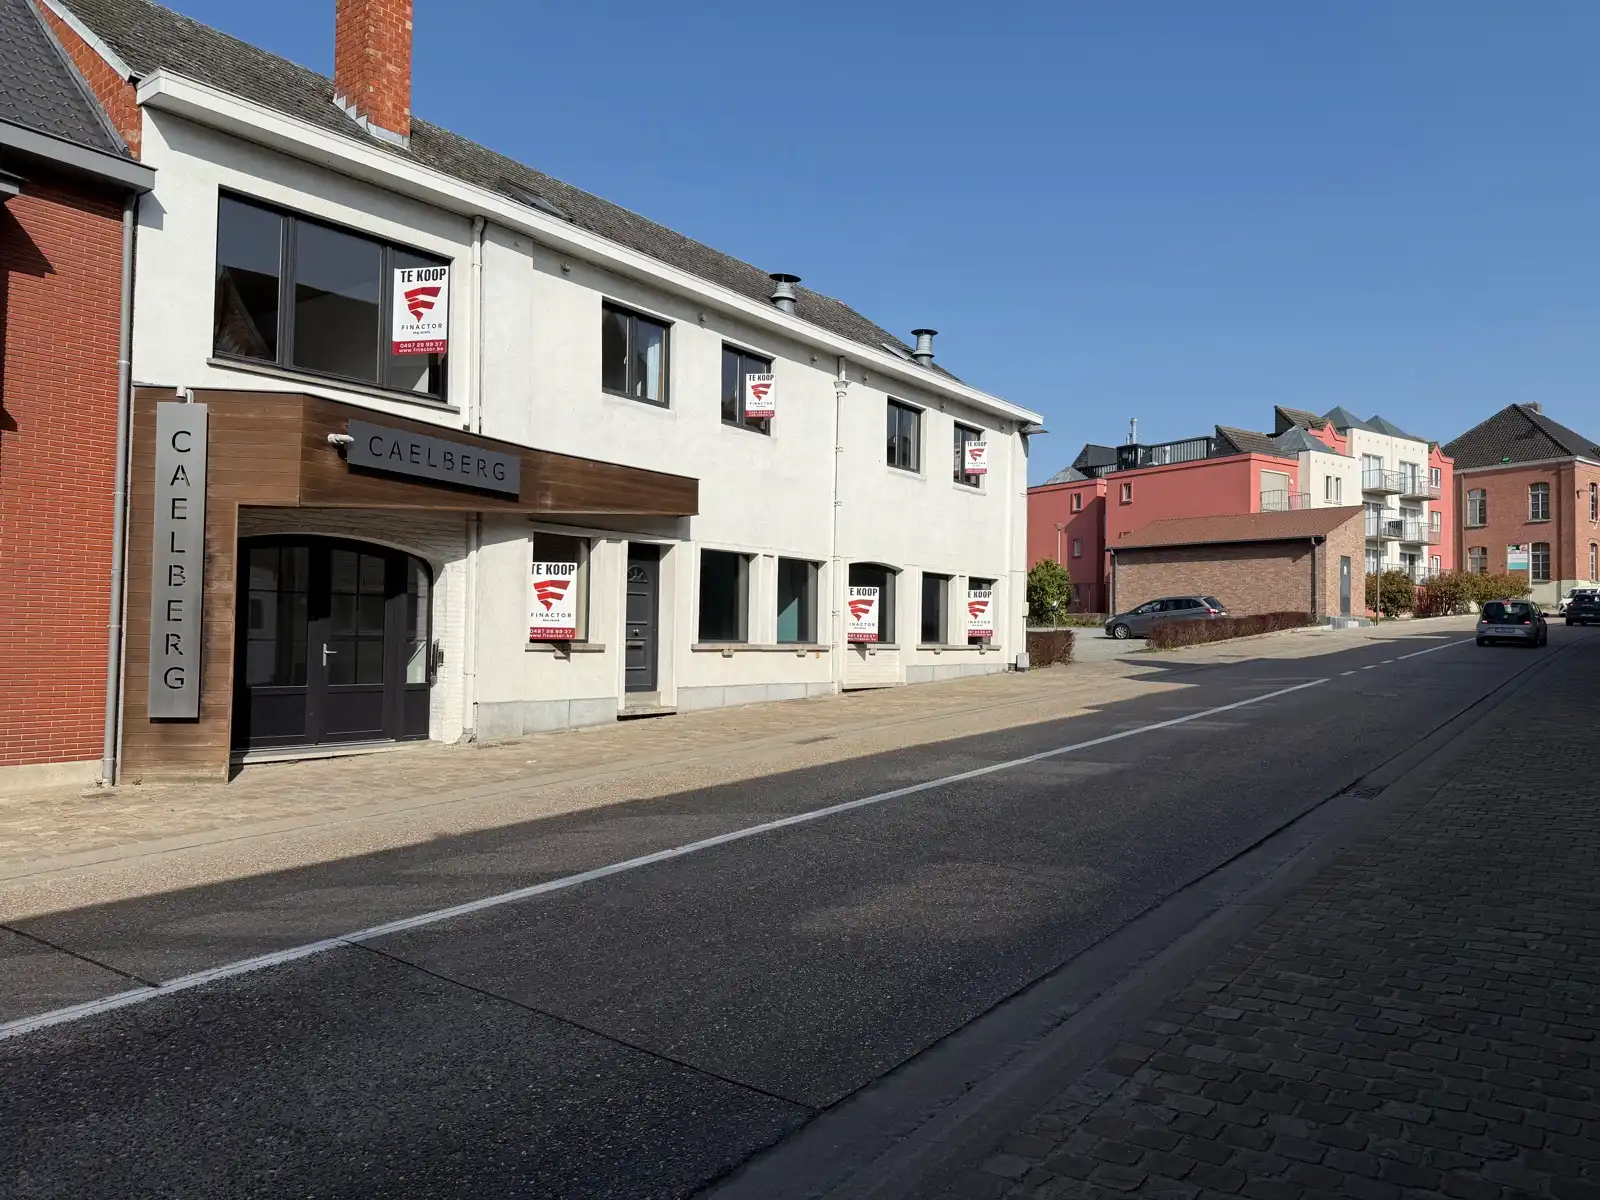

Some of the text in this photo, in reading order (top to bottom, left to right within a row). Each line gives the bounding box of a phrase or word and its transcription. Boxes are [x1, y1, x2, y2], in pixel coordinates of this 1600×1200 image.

[401, 268, 446, 283] TE KOOP
[369, 435, 506, 482] CAELBERG
[163, 430, 192, 690] CAELBERG
[546, 564, 575, 575] KOOP
[848, 588, 877, 596] E KOOP
